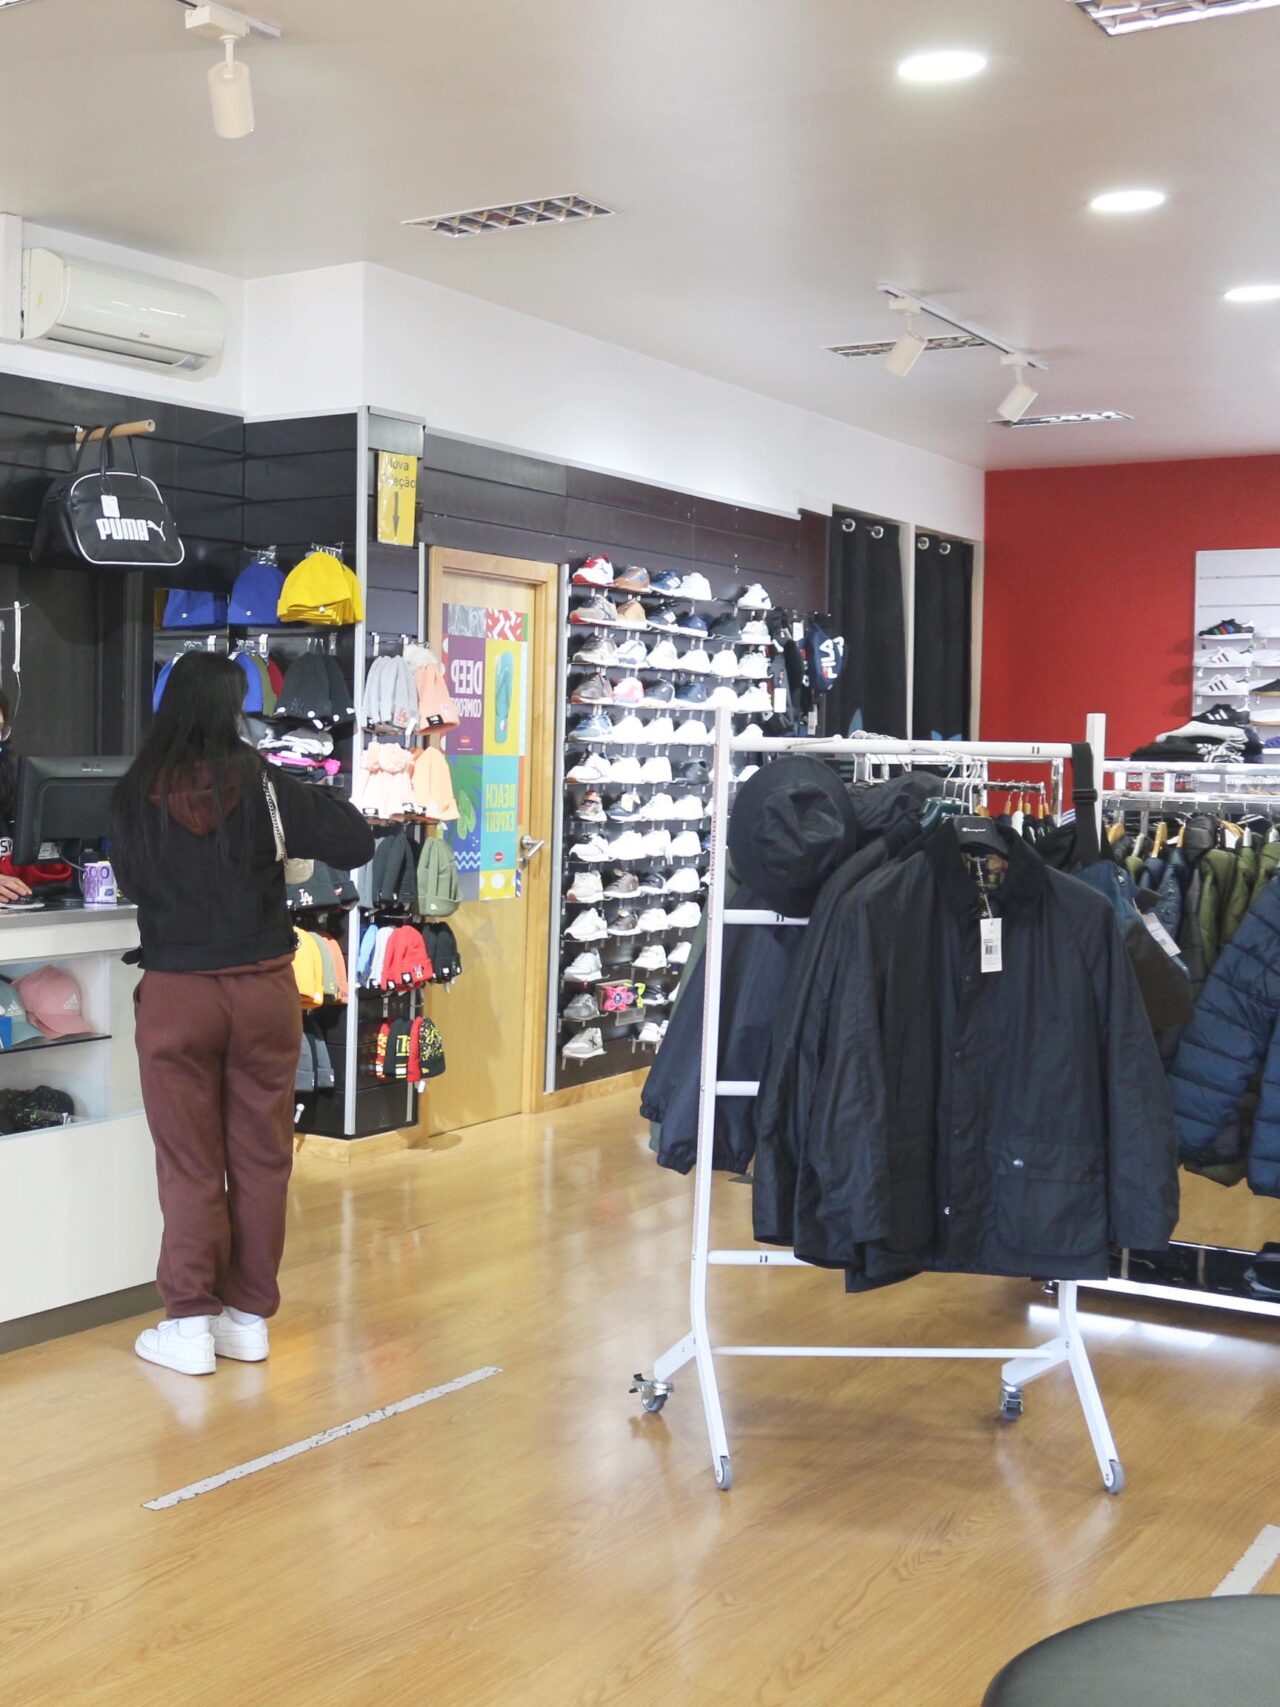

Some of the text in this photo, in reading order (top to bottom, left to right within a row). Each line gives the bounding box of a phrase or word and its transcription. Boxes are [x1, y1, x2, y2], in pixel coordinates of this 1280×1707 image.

[95, 517, 150, 542] PUMA
[819, 638, 839, 679] FILA
[298, 888, 314, 906] LA
